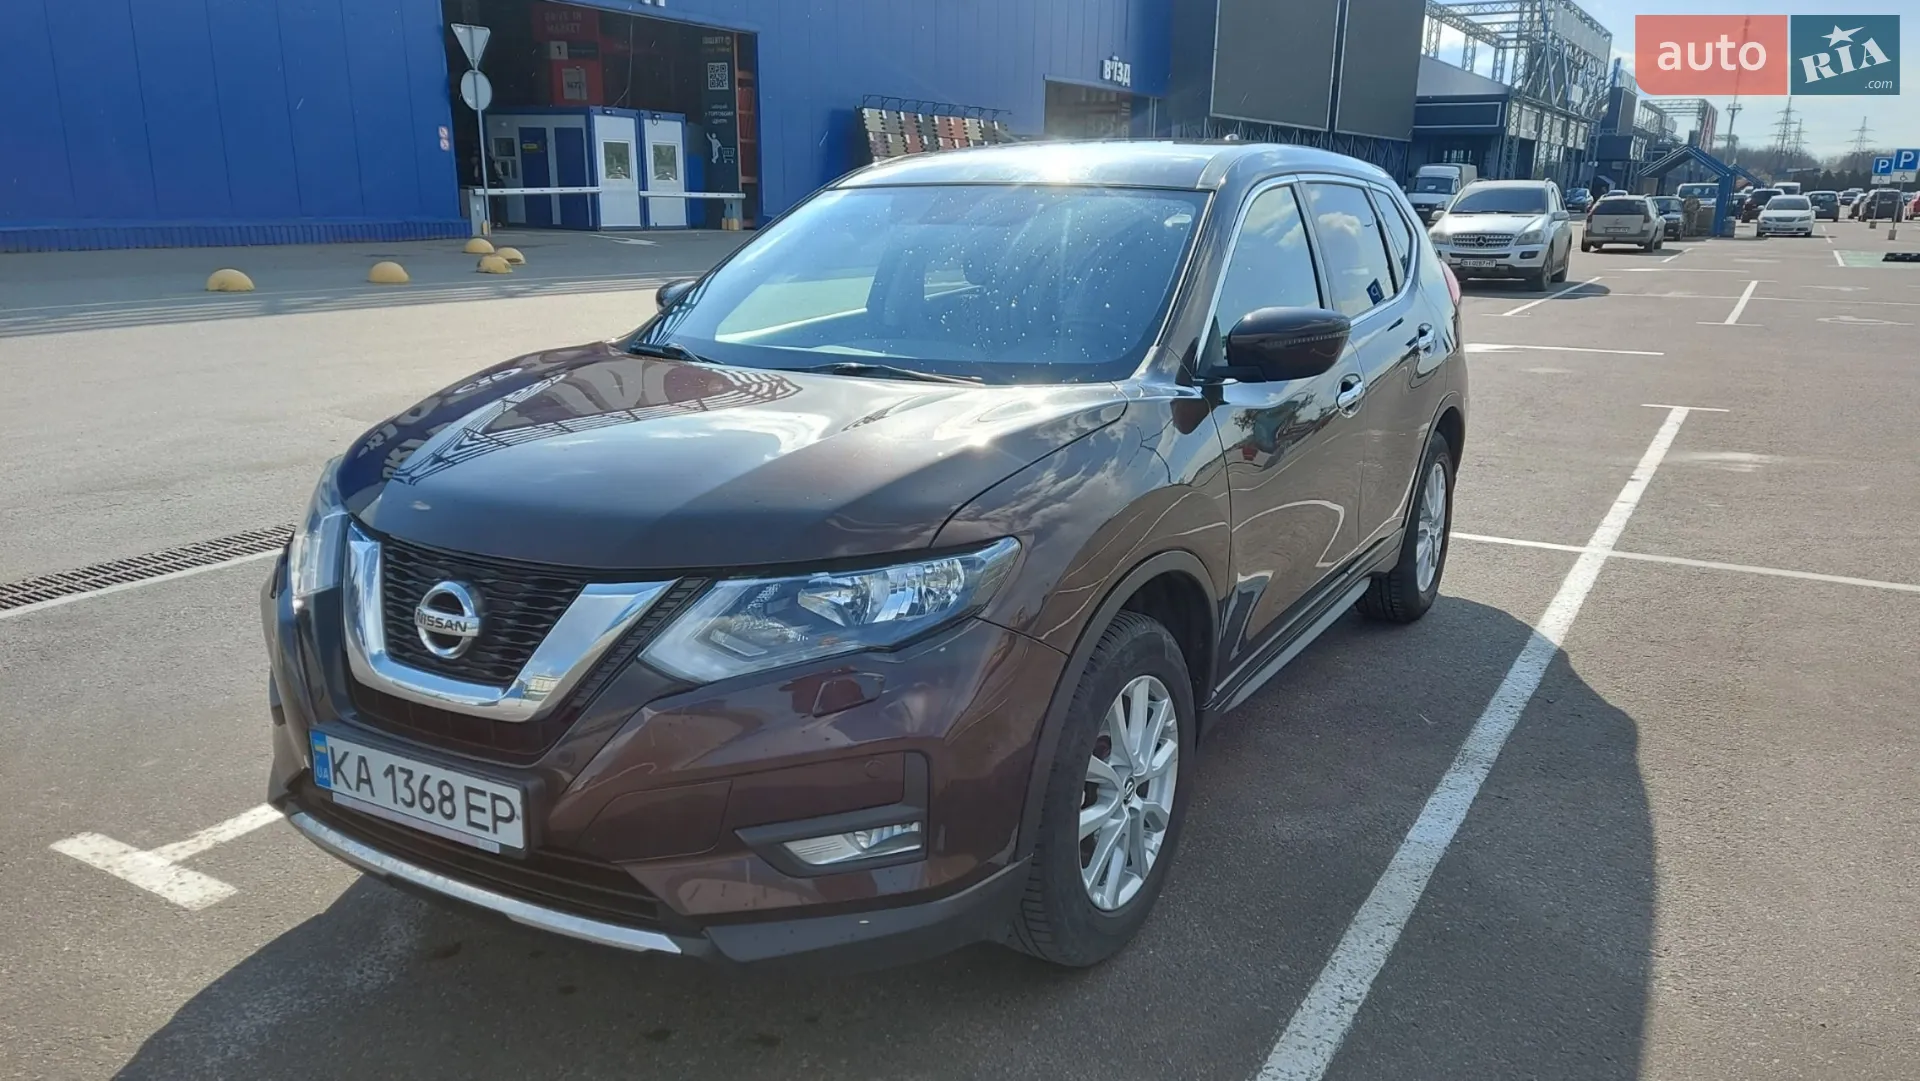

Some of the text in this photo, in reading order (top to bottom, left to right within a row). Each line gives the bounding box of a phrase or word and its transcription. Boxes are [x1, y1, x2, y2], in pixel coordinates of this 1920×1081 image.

[1877, 159, 1889, 173] P
[1899, 151, 1914, 168] P
[416, 608, 468, 633] NISSAN
[316, 765, 329, 779] UA
[330, 746, 516, 835] KA 1368 EP
